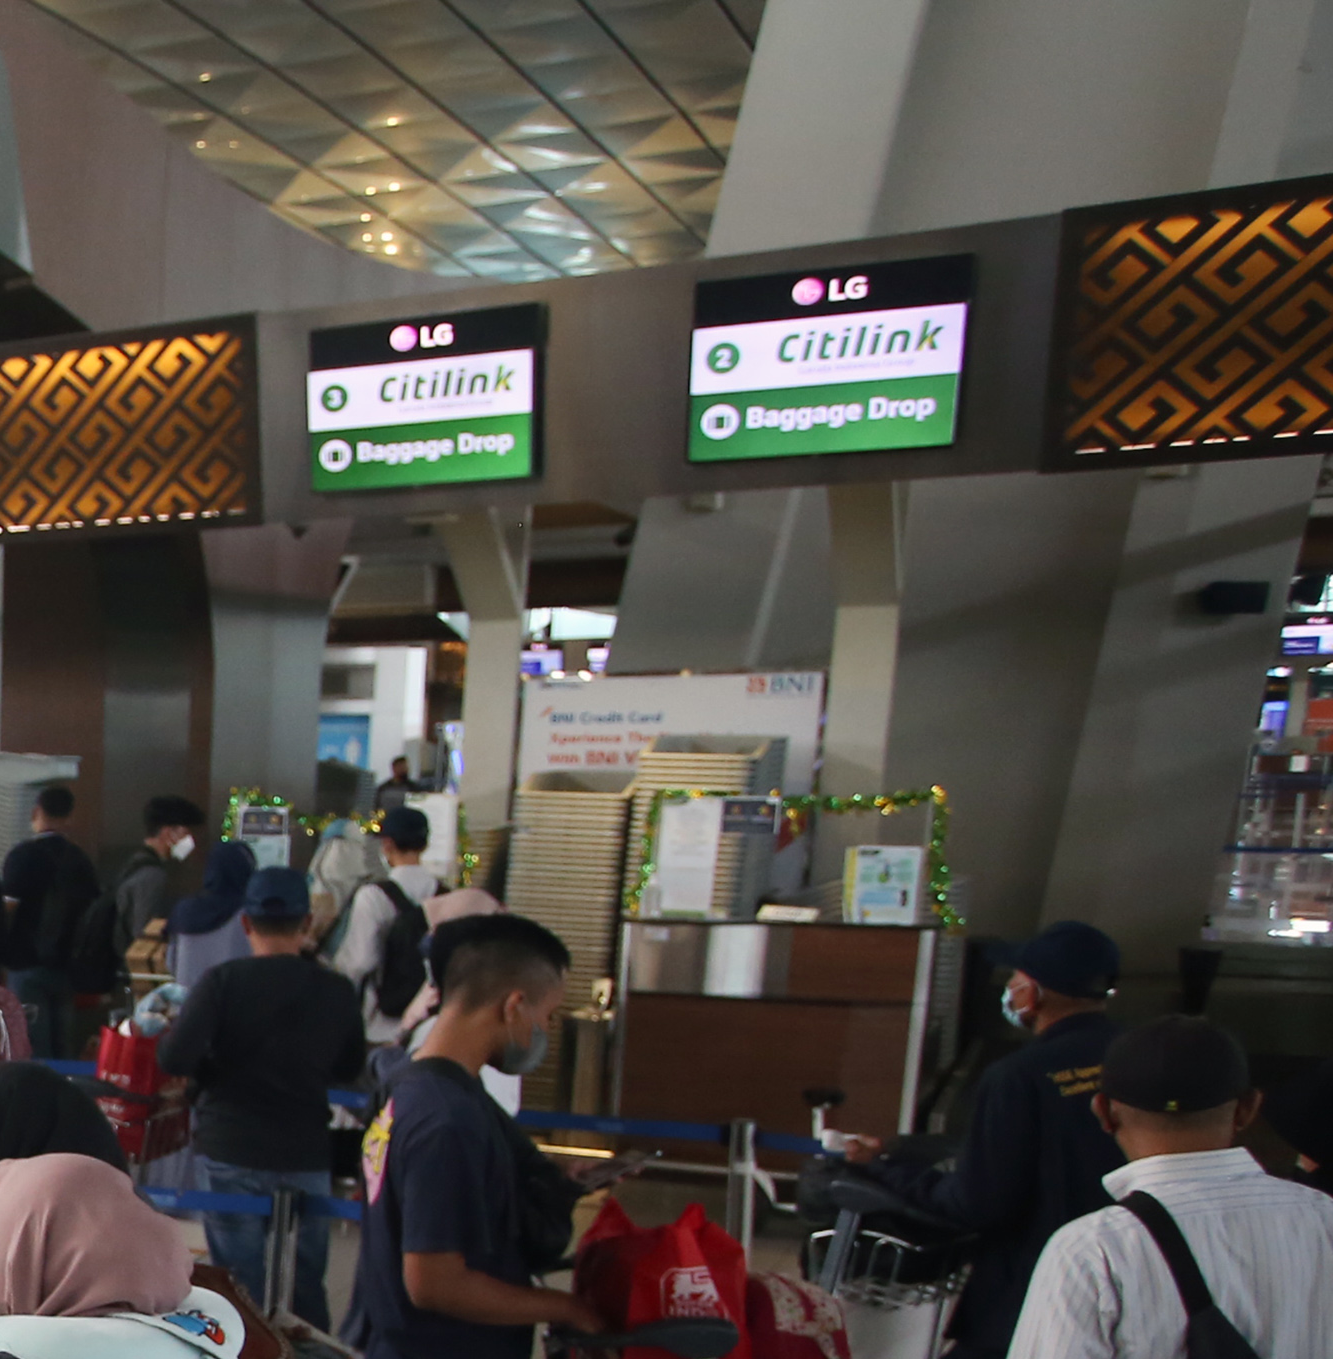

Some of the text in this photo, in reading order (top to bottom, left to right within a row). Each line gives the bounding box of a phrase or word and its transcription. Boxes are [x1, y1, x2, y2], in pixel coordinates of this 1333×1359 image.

[828, 275, 868, 301] LG
[419, 322, 454, 348] LG
[778, 320, 944, 363] Citilink
[714, 348, 733, 368] 2
[380, 365, 515, 403] Citilink
[326, 388, 344, 408] 3
[745, 396, 937, 432] Baggage Drop
[356, 432, 515, 465] Baggage Drop
[770, 676, 814, 693] BNI
[580, 711, 623, 724] Credit
[628, 711, 664, 724] Card
